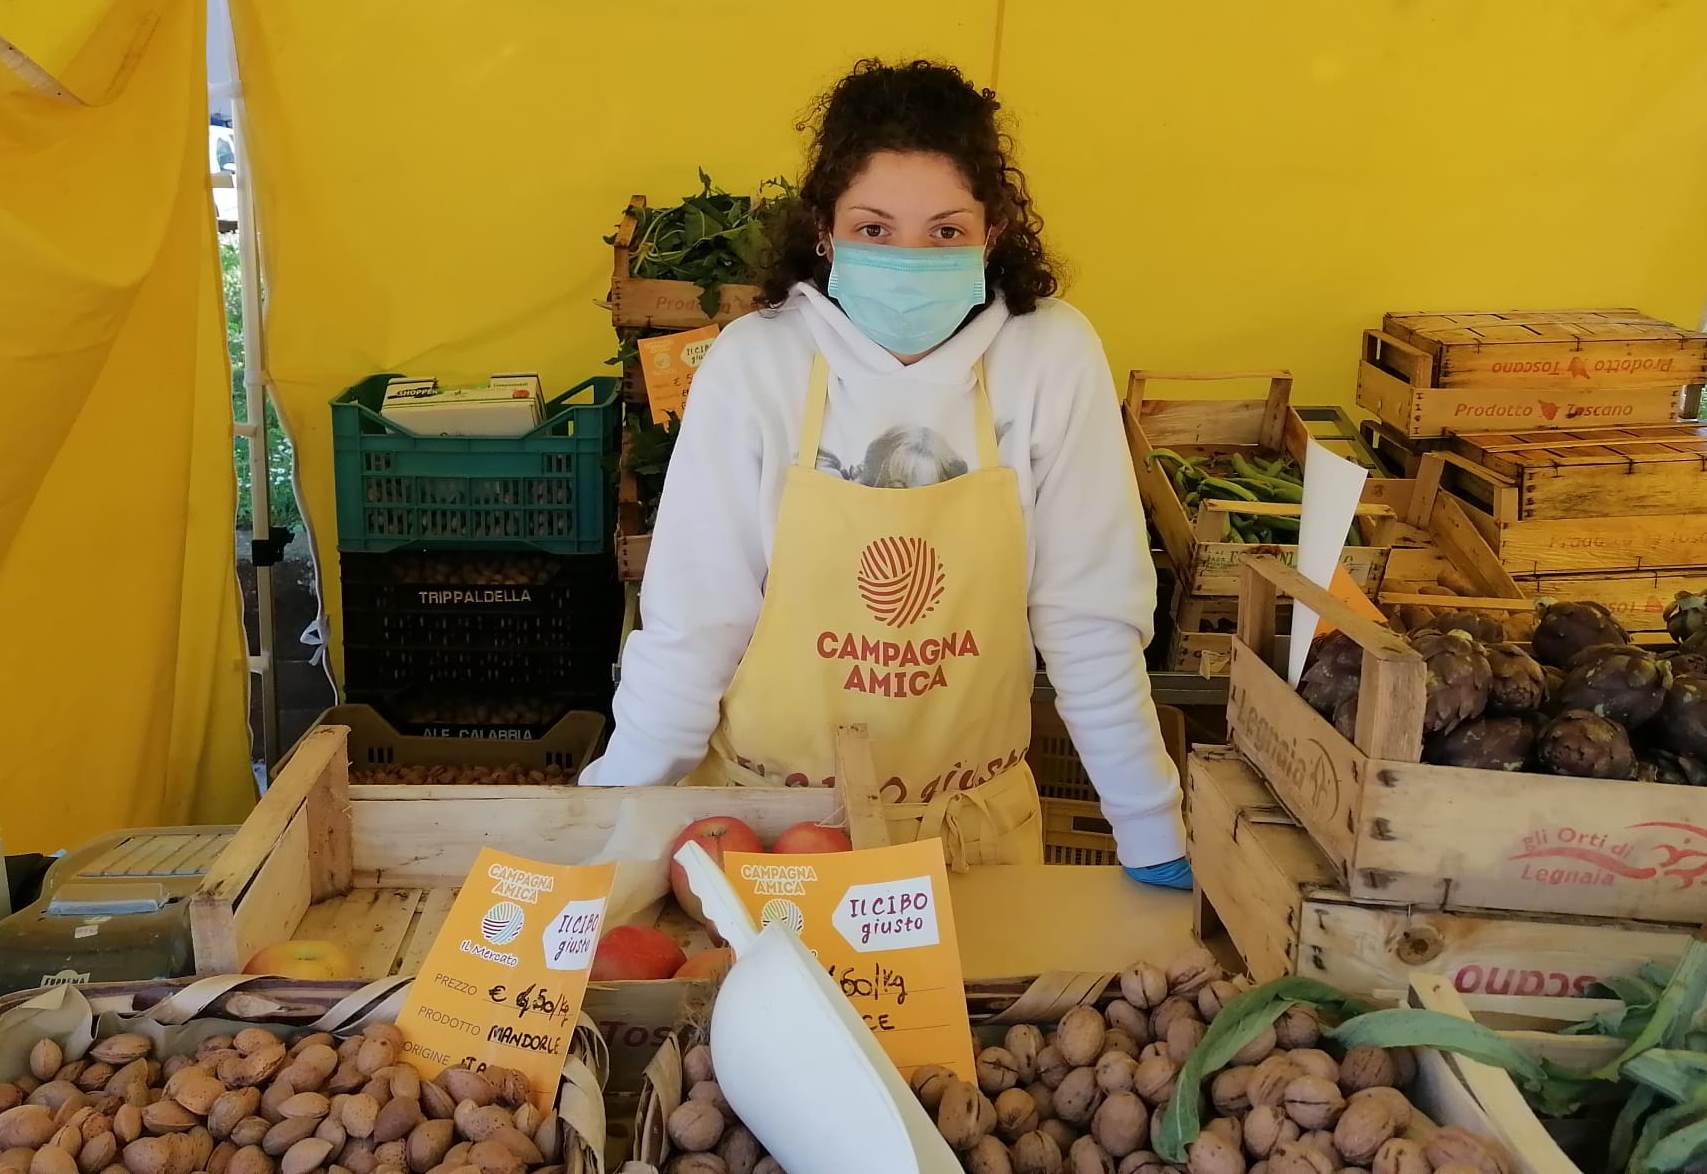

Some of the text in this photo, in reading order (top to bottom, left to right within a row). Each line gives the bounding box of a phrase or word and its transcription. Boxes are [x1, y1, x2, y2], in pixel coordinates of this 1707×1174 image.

[1492, 357, 1673, 375] Prodotto Toscano
[1454, 403, 1633, 417] Prodotto Toscano
[418, 589, 532, 604] TRIPPALDELLA
[816, 630, 980, 667] CAMPAGNA
[843, 664, 948, 697] AMICA
[1557, 827, 1609, 848] Orti
[1611, 841, 1635, 858] di
[489, 865, 553, 890] CAMPAGNA
[741, 865, 816, 881] CAMPAGNA
[1520, 864, 1616, 886] Legnaia
[493, 880, 538, 903] AMICA
[756, 881, 804, 895] AMICA
[872, 892, 928, 916] CIBO
[861, 917, 923, 944] giusto
[470, 945, 517, 966] Mercato
[554, 938, 591, 961] giusto
[434, 973, 478, 996] PREZZO
[488, 985, 508, 1002] €
[418, 1006, 561, 1055] PRODOTTO MANDORLE
[402, 1040, 451, 1066] ORIGINE
